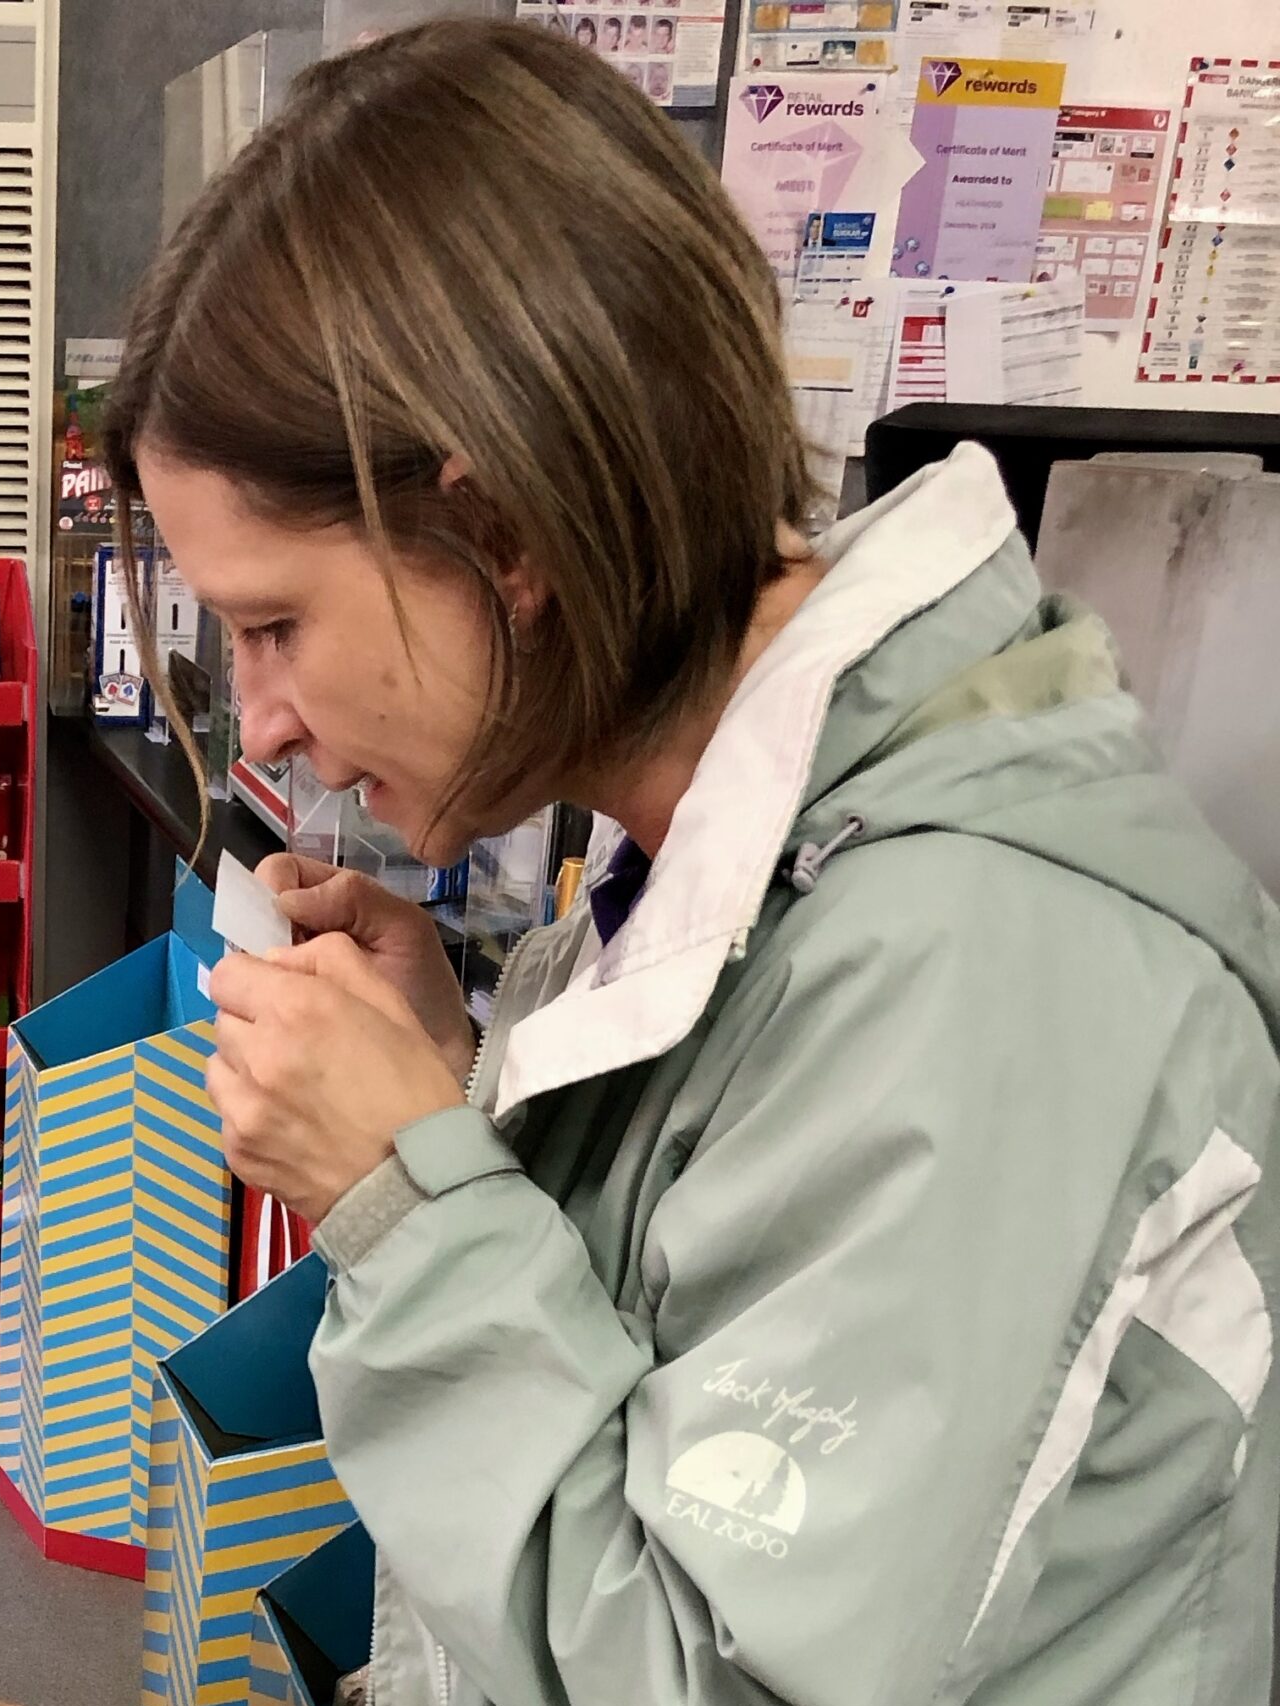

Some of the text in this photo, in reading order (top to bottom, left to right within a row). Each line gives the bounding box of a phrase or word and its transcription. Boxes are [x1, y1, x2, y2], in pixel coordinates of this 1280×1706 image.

[965, 79, 1037, 95] rewards
[786, 101, 865, 117] rewards
[751, 141, 843, 152] Certificate of Merit
[936, 144, 1027, 157] Certificate of Merit
[952, 174, 1013, 186] Awarded to
[702, 1357, 772, 1409] Jack
